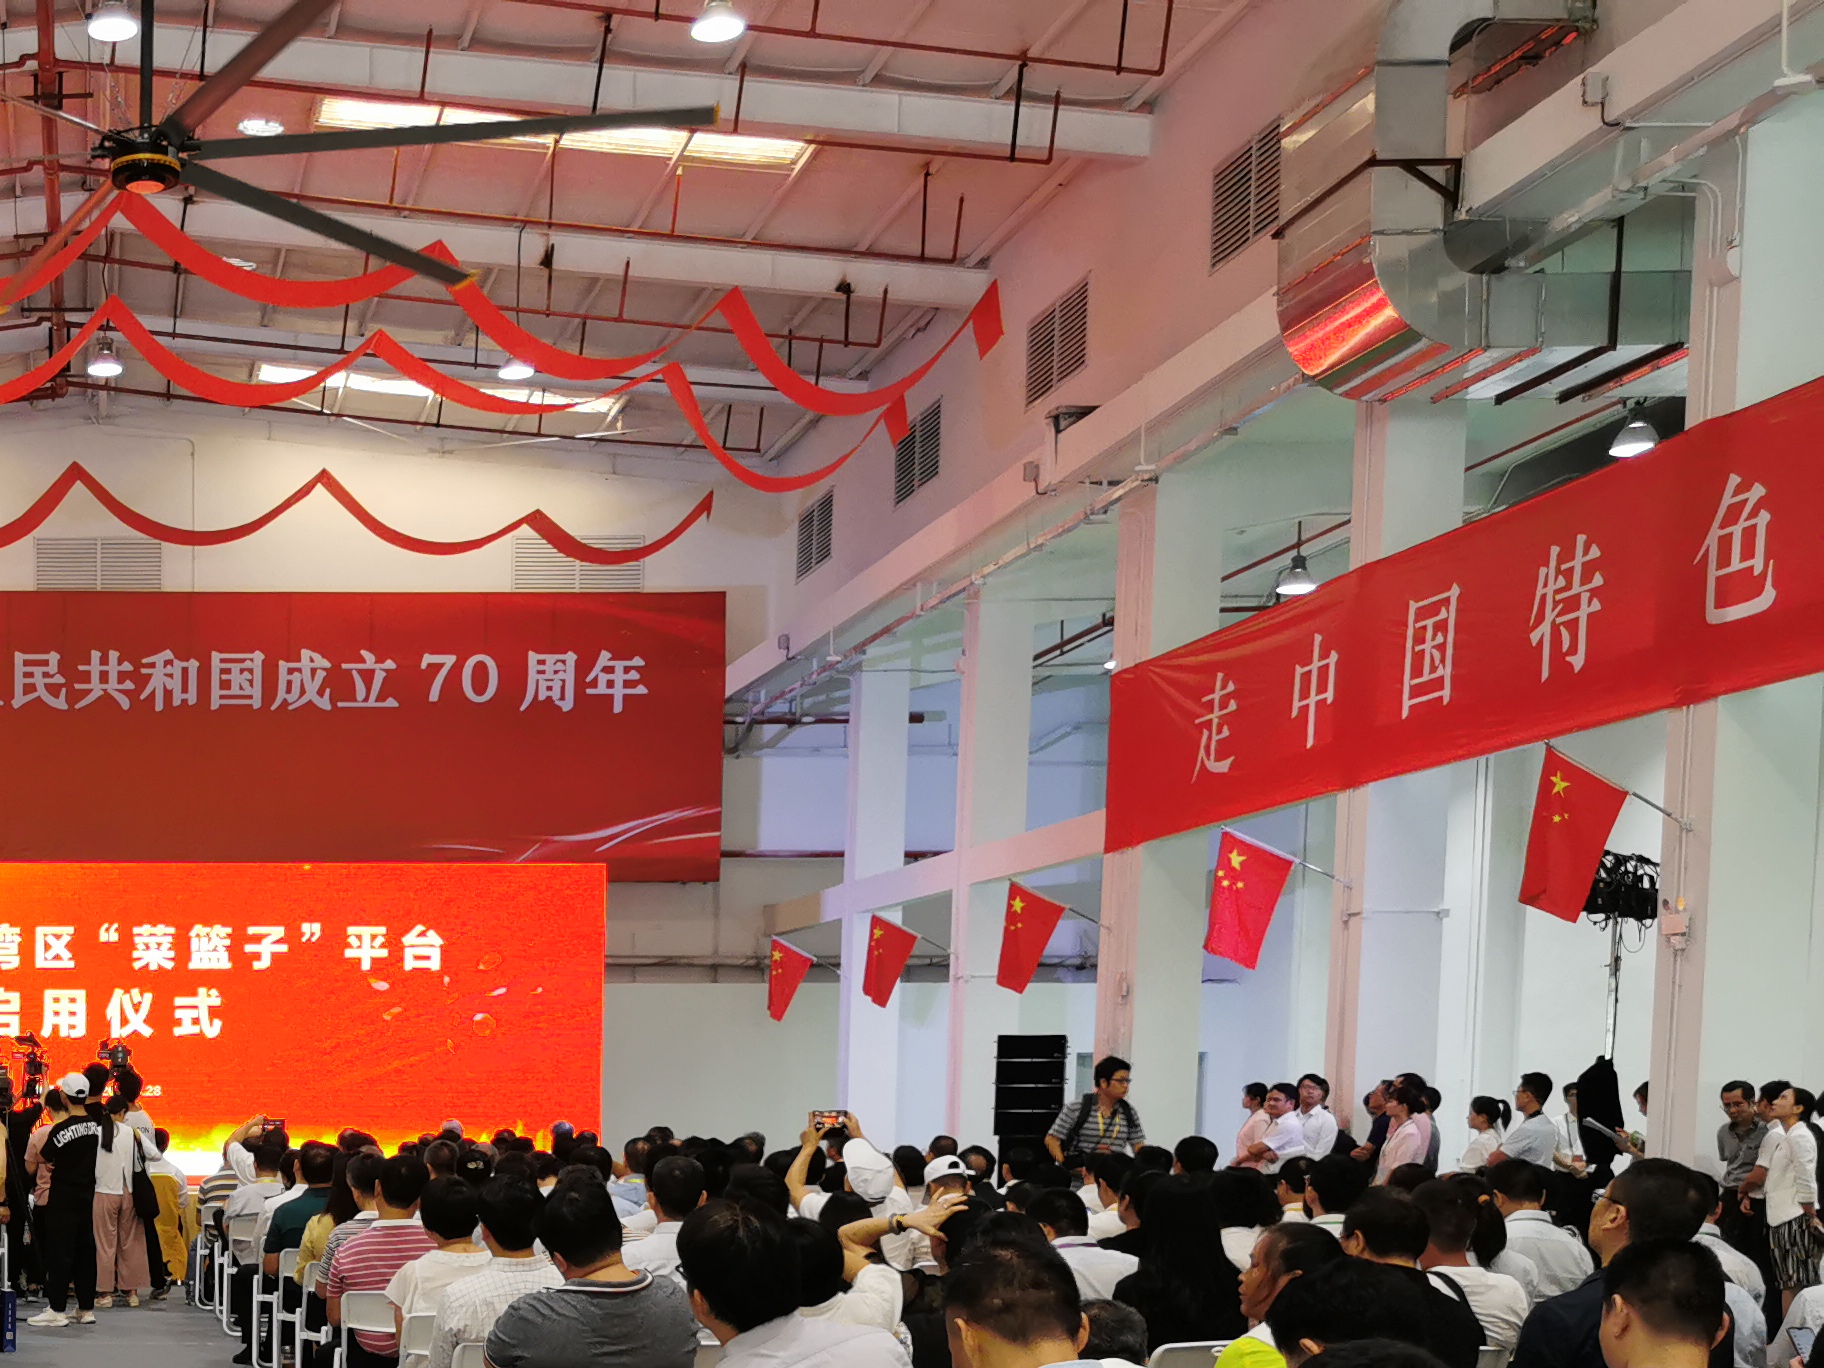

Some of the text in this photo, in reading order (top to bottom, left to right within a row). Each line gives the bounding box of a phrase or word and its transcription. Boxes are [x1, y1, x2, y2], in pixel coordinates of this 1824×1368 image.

[1190, 472, 1777, 784] 走中国特色
